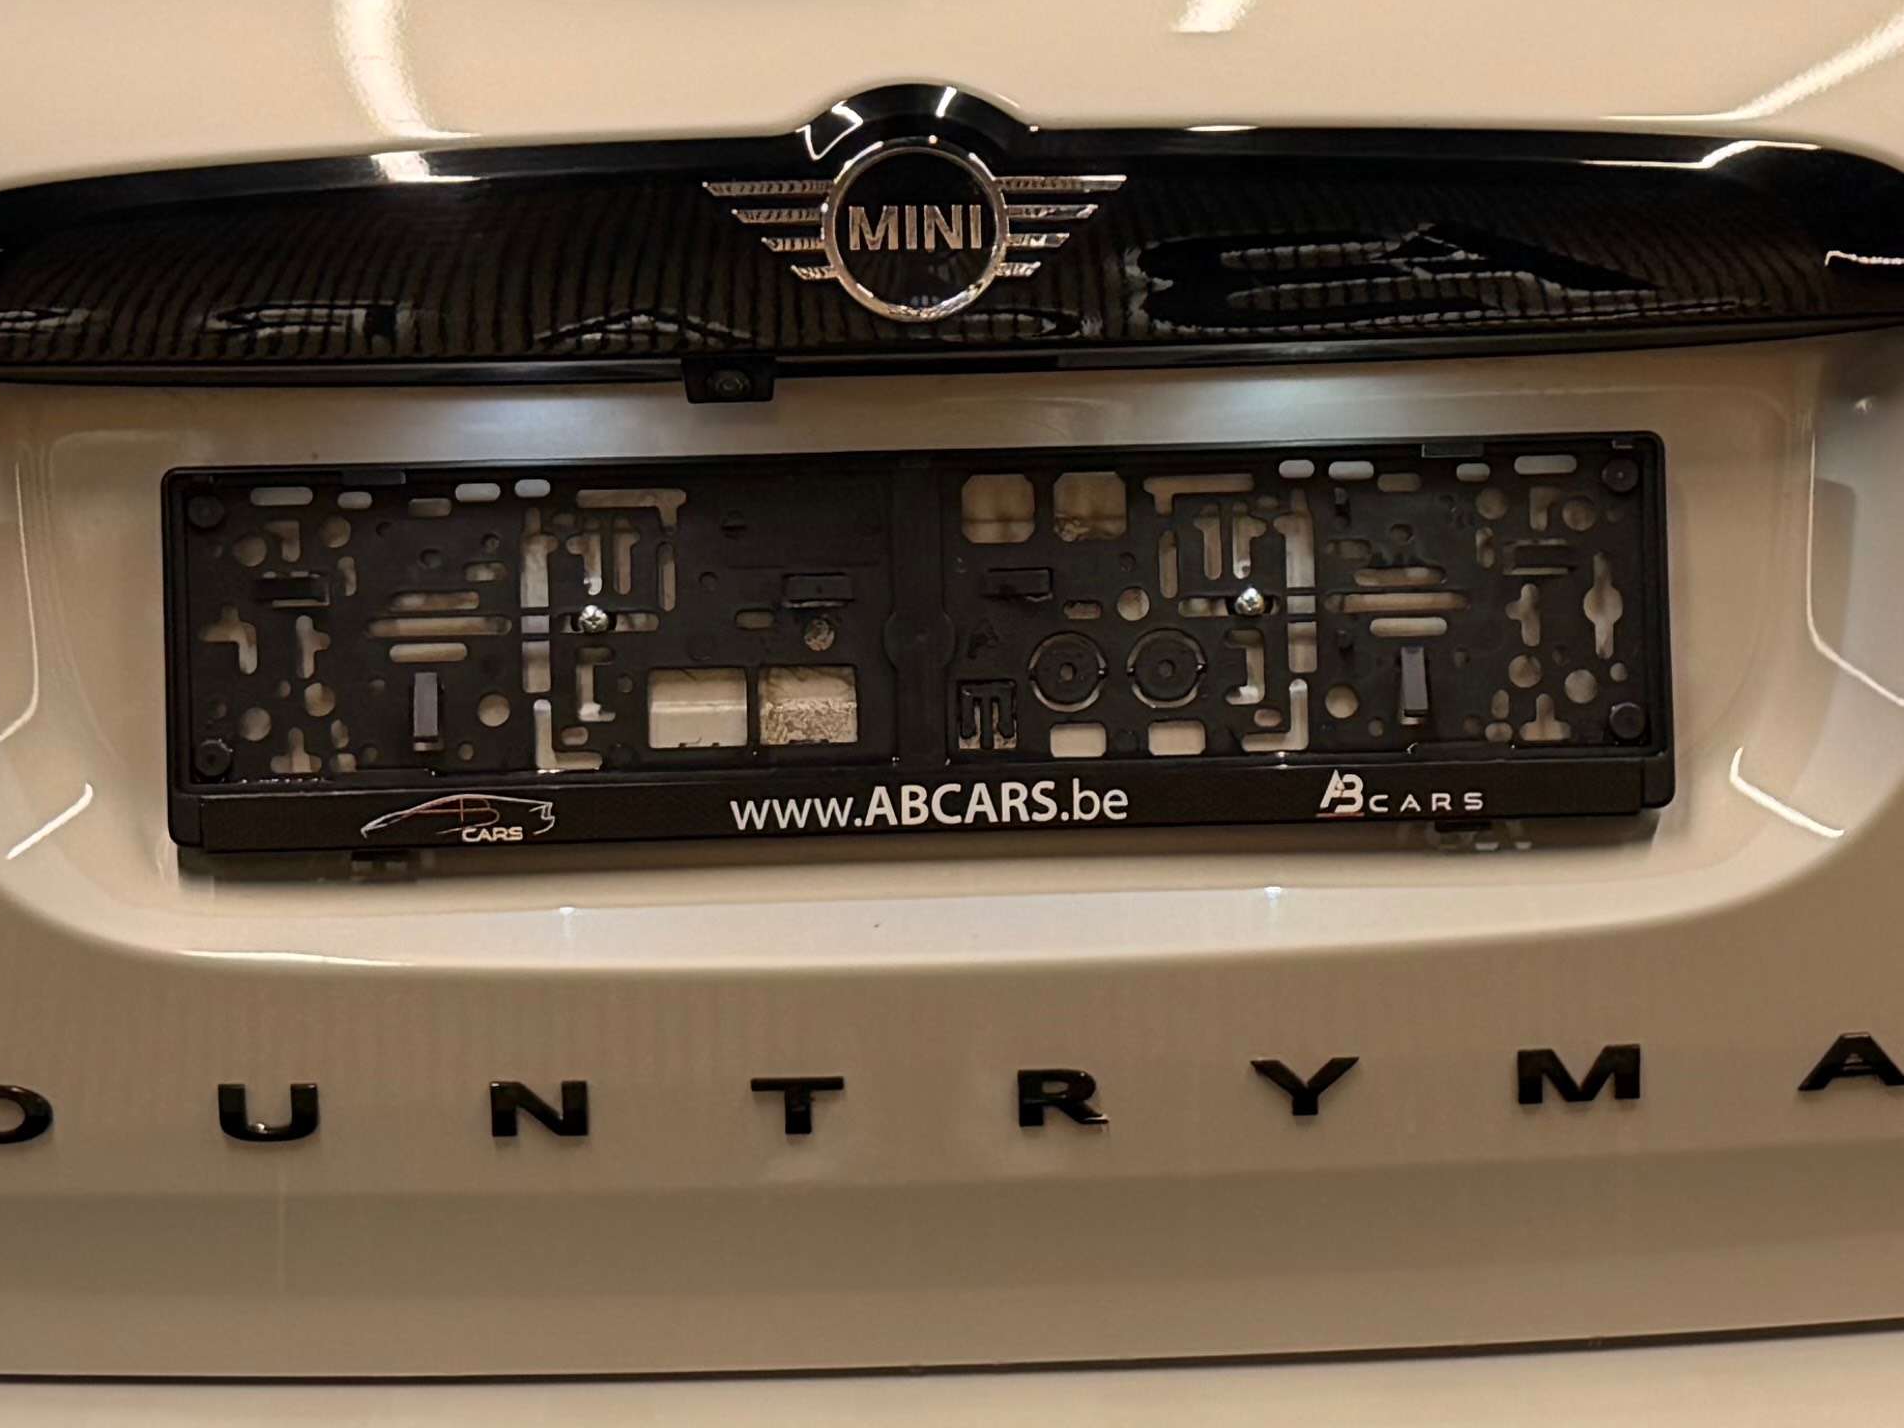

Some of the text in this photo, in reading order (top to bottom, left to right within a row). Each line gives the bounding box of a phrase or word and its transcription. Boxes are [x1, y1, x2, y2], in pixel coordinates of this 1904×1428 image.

[848, 204, 983, 251] MINI
[729, 778, 1129, 830] www.ABCARS.be
[462, 826, 523, 843] CARS
